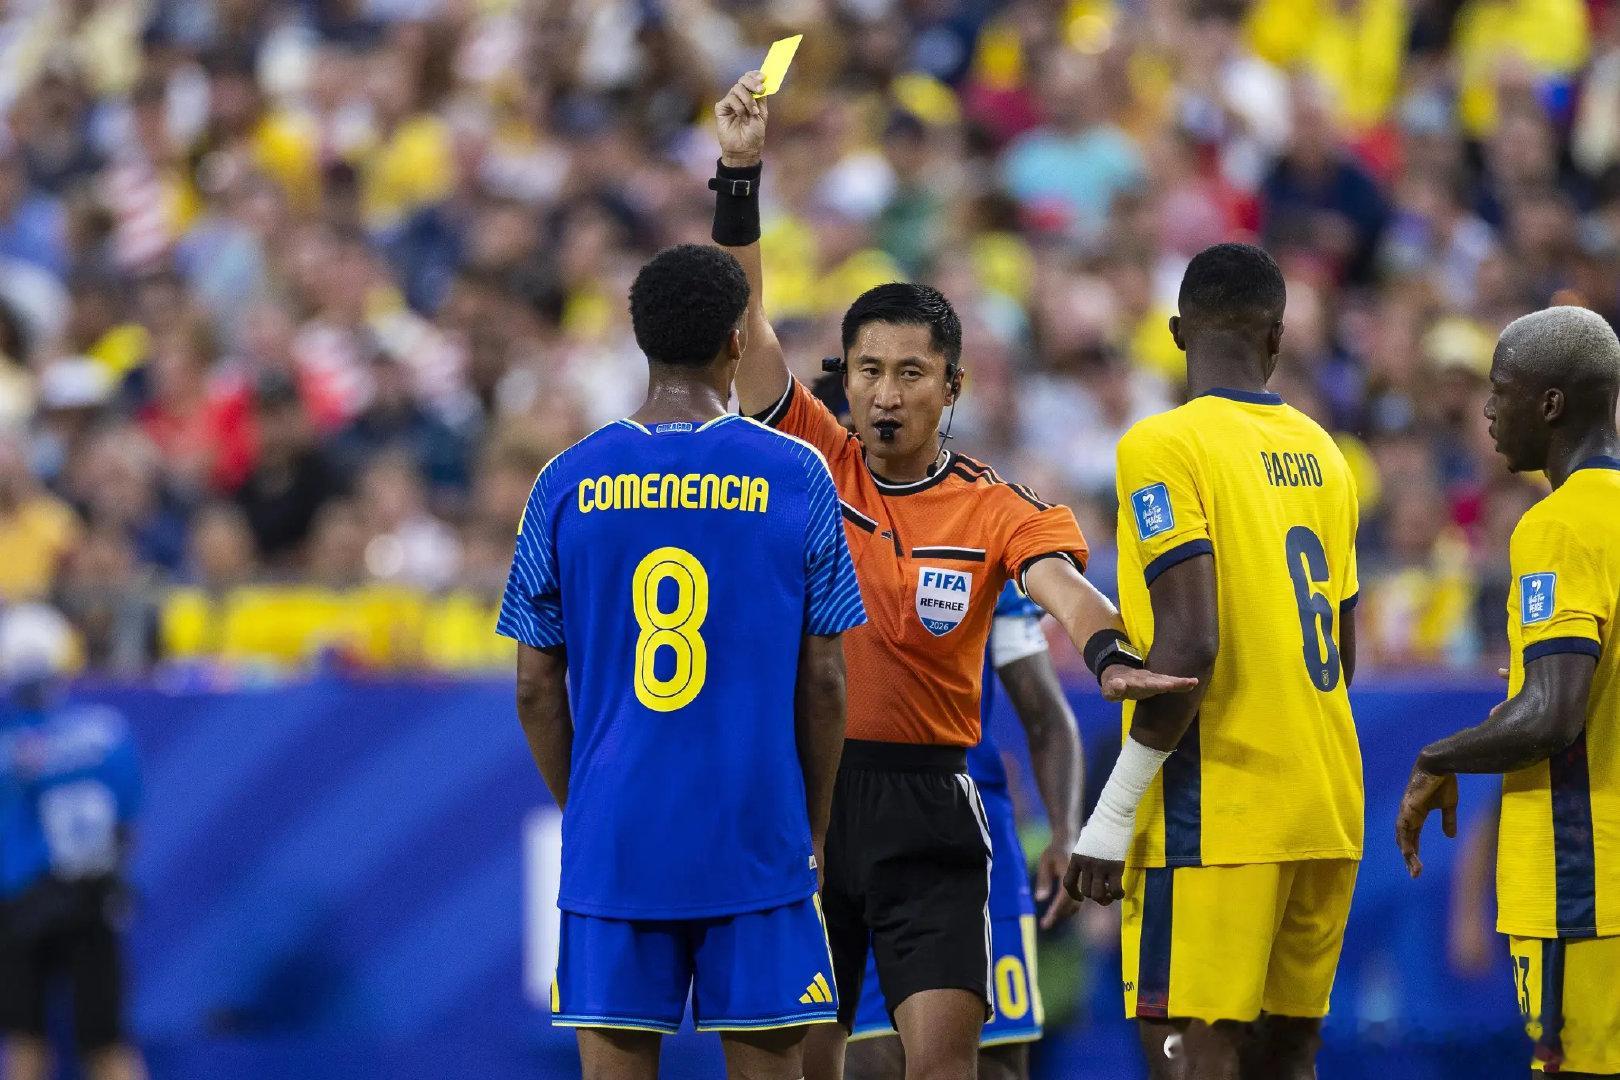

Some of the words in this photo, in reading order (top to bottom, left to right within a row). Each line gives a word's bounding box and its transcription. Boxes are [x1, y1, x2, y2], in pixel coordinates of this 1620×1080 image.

[1260, 451, 1323, 487] PACHO
[578, 473, 770, 514] COMENENCIA
[923, 571, 967, 592] FIFA
[920, 597, 964, 612] REFEREE
[1285, 525, 1340, 692] 6
[632, 546, 709, 712] 8
[929, 621, 949, 630] 2026
[994, 954, 1029, 1020] 0
